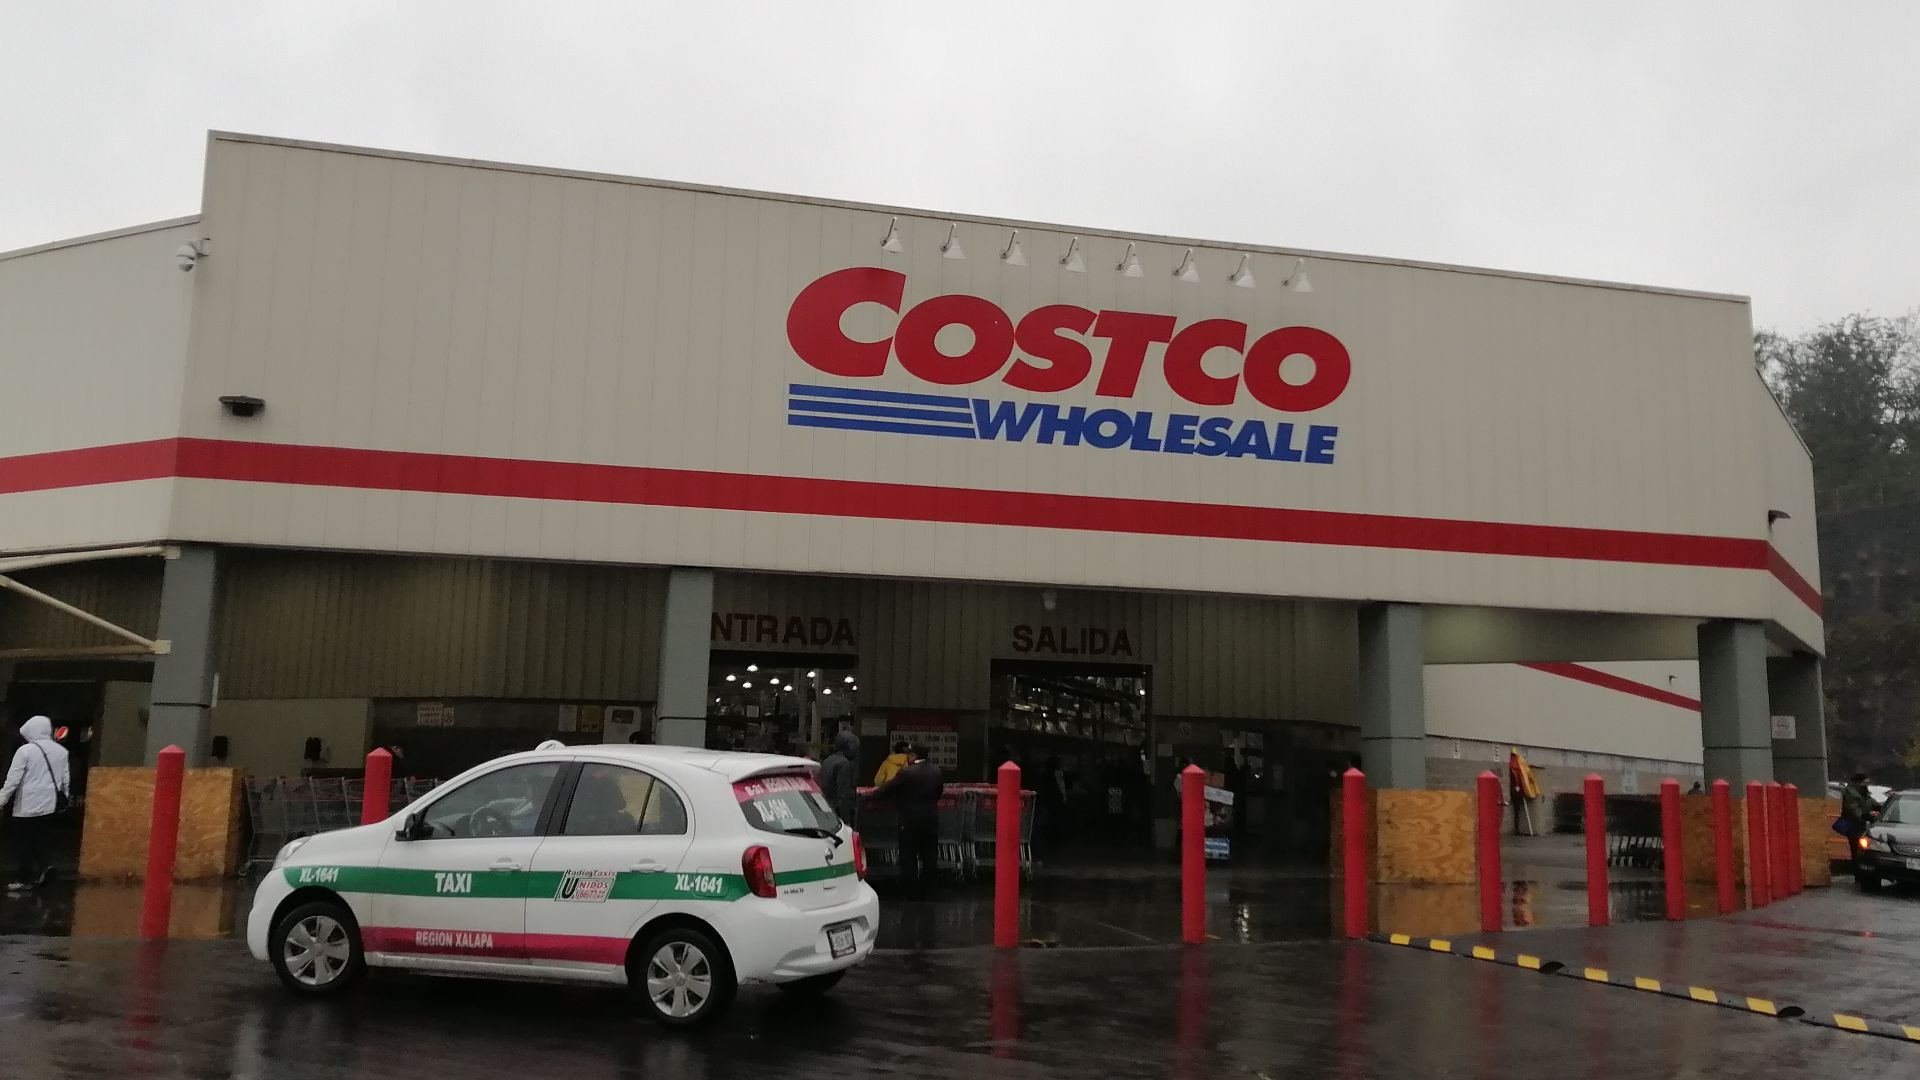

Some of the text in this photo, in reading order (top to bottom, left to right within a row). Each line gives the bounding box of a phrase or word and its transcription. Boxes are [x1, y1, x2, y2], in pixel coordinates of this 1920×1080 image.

[786, 266, 1351, 412] COSTCO
[971, 398, 1339, 464] WHOLESALE
[711, 612, 856, 646] NTRADA
[1012, 624, 1133, 657] SALIDA
[299, 867, 340, 883] XL-1641
[434, 872, 473, 893] TAXI
[675, 874, 723, 894] XL-1641
[415, 931, 494, 949] REGION XALAPA
